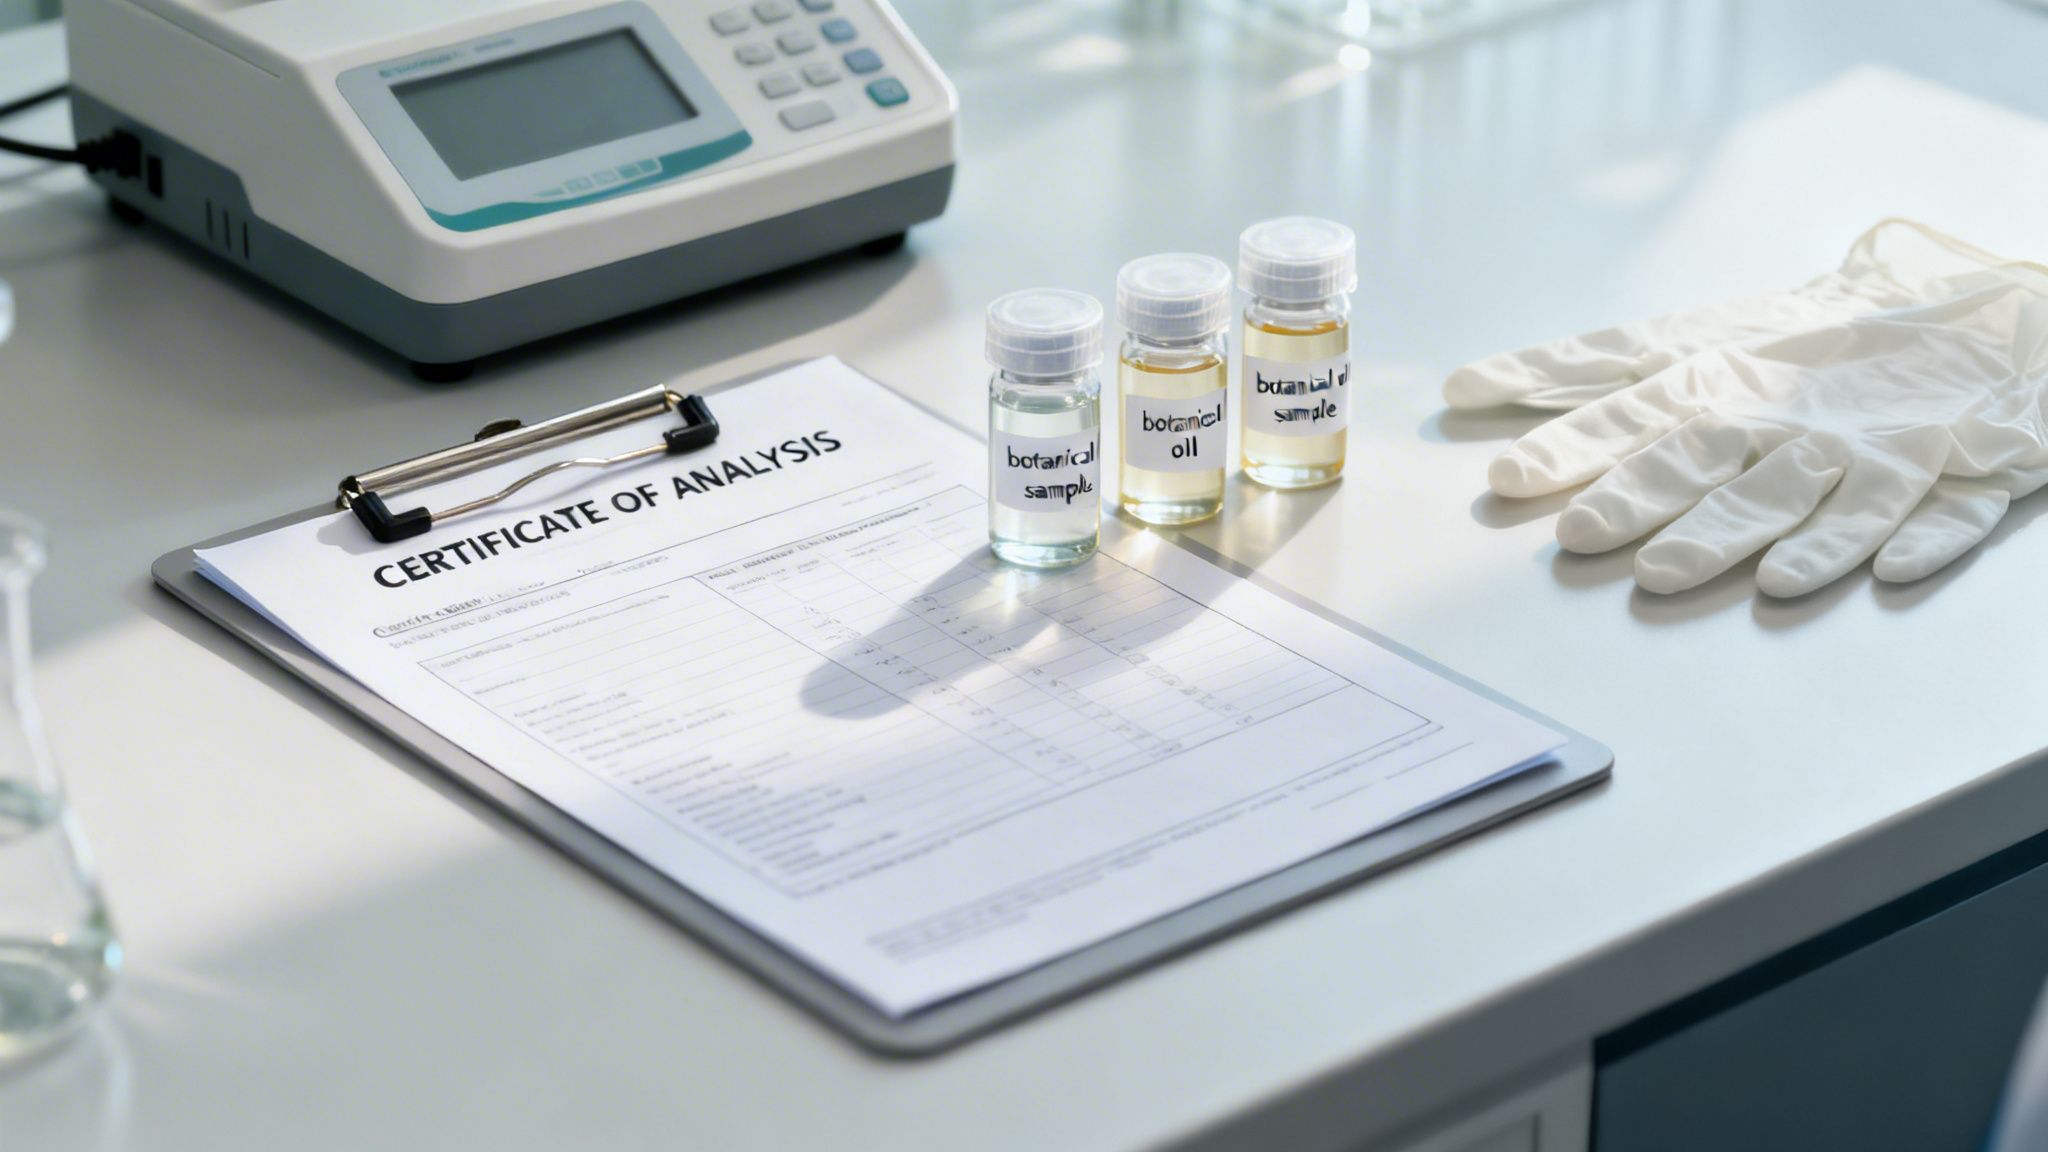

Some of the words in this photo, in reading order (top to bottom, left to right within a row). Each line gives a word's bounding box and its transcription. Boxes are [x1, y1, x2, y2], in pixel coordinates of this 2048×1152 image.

[373, 499, 610, 589] CERTIFICATE
[610, 483, 659, 514] OF
[672, 430, 843, 500] ANALYSIS
